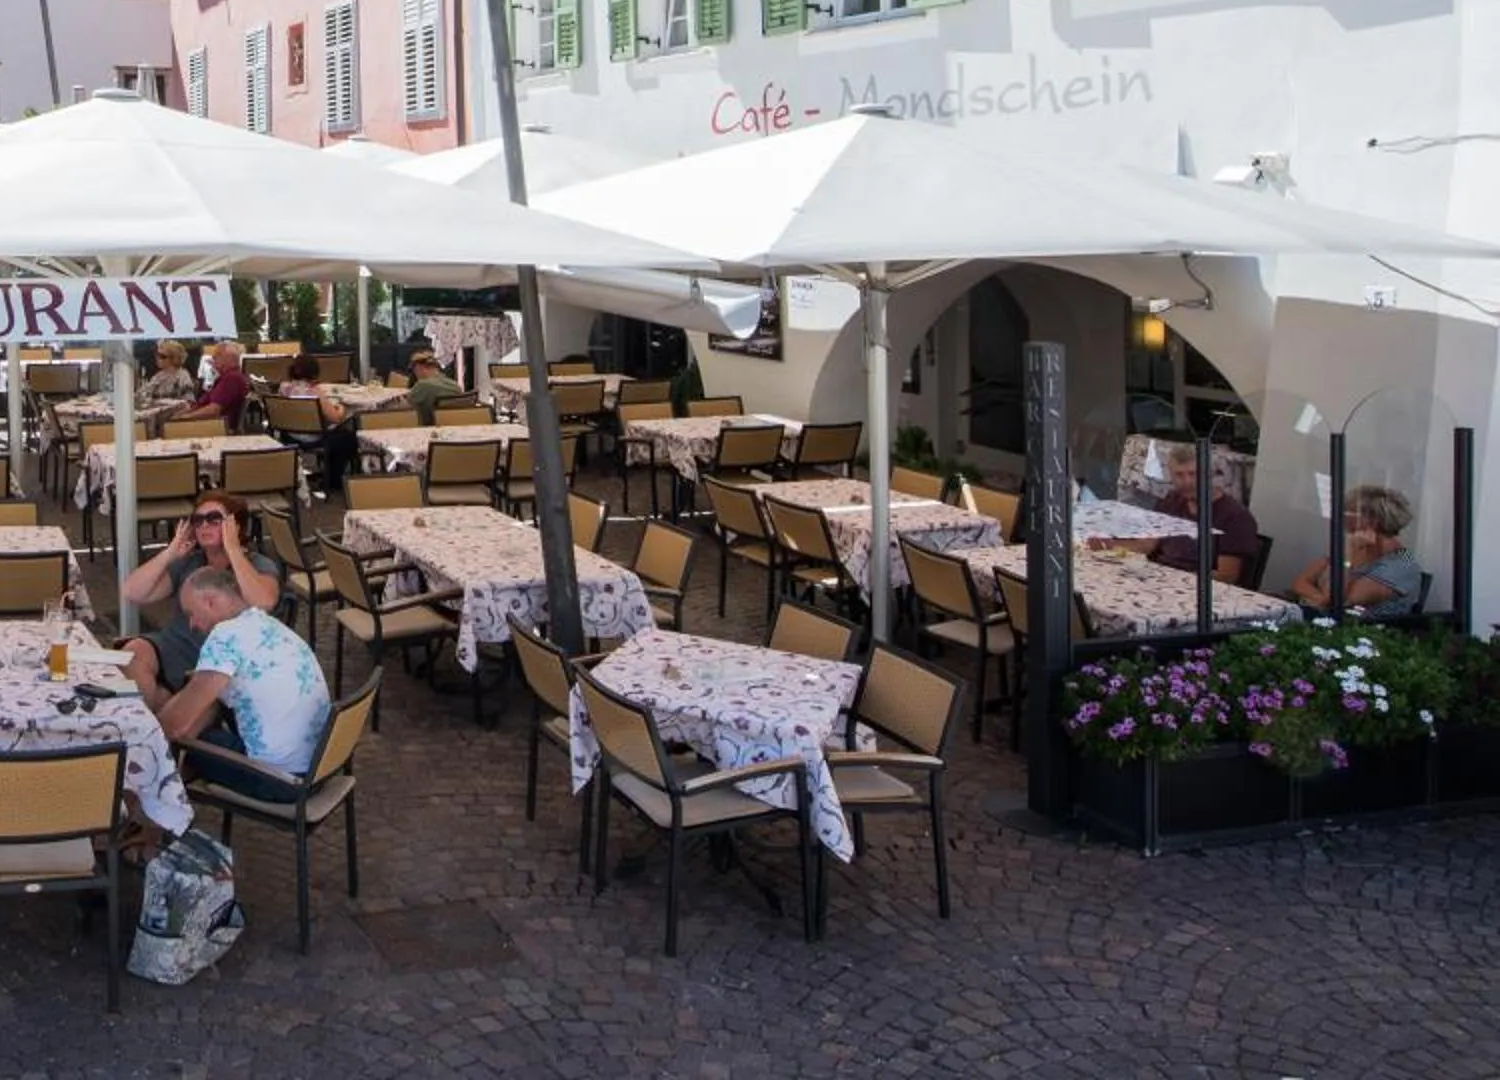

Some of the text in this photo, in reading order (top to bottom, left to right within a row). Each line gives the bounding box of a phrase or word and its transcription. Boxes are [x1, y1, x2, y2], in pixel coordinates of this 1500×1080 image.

[709, 81, 791, 138] Café
[838, 53, 1154, 121] Mondschein
[1045, 352, 1065, 599] RESTAURANT
